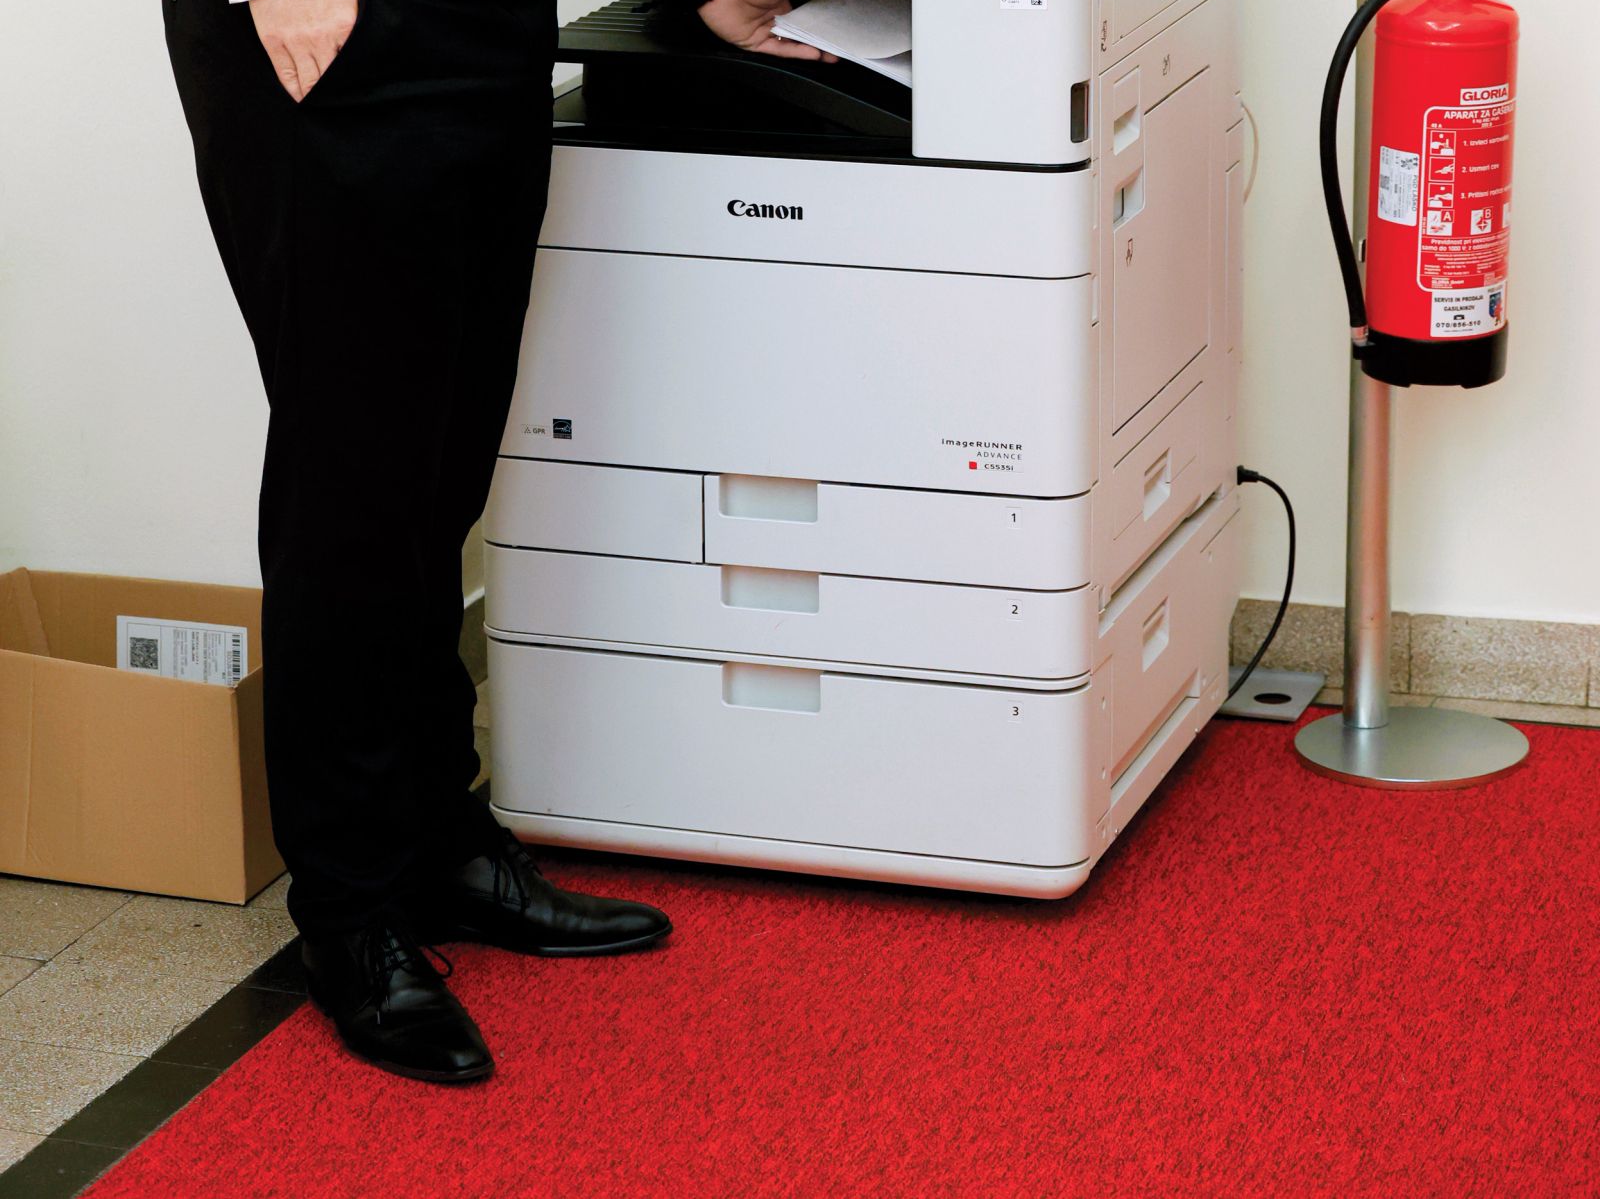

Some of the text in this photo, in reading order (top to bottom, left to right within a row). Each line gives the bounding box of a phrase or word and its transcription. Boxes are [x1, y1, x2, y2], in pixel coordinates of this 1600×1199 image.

[1462, 88, 1508, 101] GLORIA
[1444, 110, 1478, 119] APARAT
[727, 199, 803, 220] Canon
[1485, 209, 1491, 218] B
[1443, 211, 1451, 221] A
[1434, 295, 1453, 303] SERVIS
[941, 438, 1023, 450] imageRUNNER
[976, 451, 1022, 460] ADVANCE
[1011, 512, 1017, 523] 1
[1011, 604, 1018, 615] 2
[1012, 706, 1019, 716] 3
